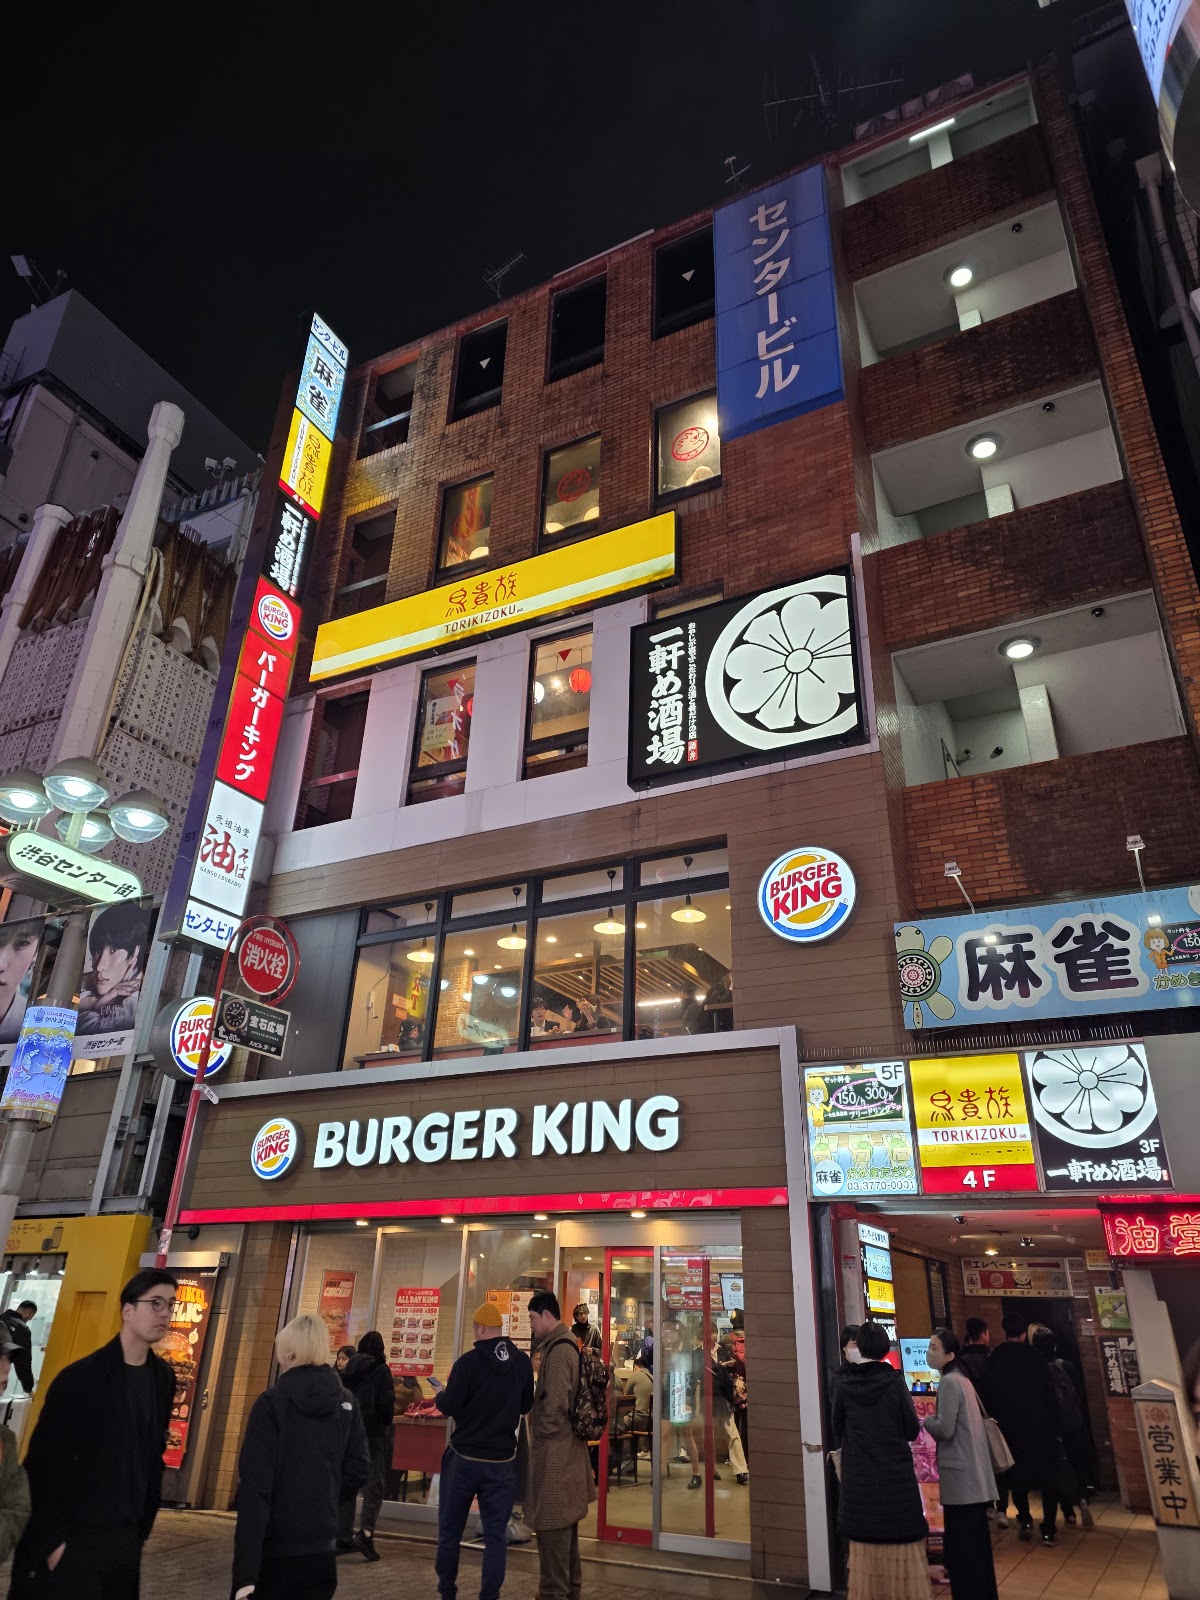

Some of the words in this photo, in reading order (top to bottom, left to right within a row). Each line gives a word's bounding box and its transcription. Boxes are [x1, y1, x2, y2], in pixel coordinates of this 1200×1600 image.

[749, 200, 800, 399] センタービル
[312, 318, 345, 361] センタービル
[309, 355, 334, 419] 麻雀
[270, 502, 302, 592] 一軒め酒場
[262, 610, 289, 629] KING
[263, 603, 289, 619] BURGER
[444, 604, 516, 634] TORIKIZOKU
[645, 626, 686, 765] 一軒め酒場
[234, 650, 278, 782] バーガーキング
[16, 845, 137, 898] 渋谷センター街
[200, 866, 218, 878] GANSO
[769, 861, 839, 899] BURGER
[773, 875, 843, 922] KING
[185, 913, 236, 942] センタービル
[252, 932, 264, 943] FIRE
[263, 936, 286, 951] HYDRANT
[243, 941, 286, 980] 消火栓
[964, 920, 1140, 1002] 麻雀
[179, 1017, 213, 1035] BURG
[249, 1015, 285, 1037] 宝石広場
[82, 1036, 126, 1050] 渋谷センター街
[881, 1064, 903, 1080] 5F
[256, 1129, 291, 1151] BURGER
[313, 1107, 520, 1168] BURGER
[531, 1095, 680, 1156] KING
[932, 1127, 1018, 1143] TORIKIZOKU
[255, 1138, 291, 1165] KING
[1139, 1138, 1160, 1154] 3F
[815, 1169, 842, 1184] 麻雀
[1046, 1156, 1162, 1183] 一軒め酒場
[1114, 1213, 1200, 1256] 油堂
[972, 1260, 1024, 1269] エレベーター
[397, 1295, 409, 1304] ALL
[410, 1295, 422, 1304] DAY
[422, 1295, 439, 1304] KING
[1148, 1424, 1188, 1520] 営業中
